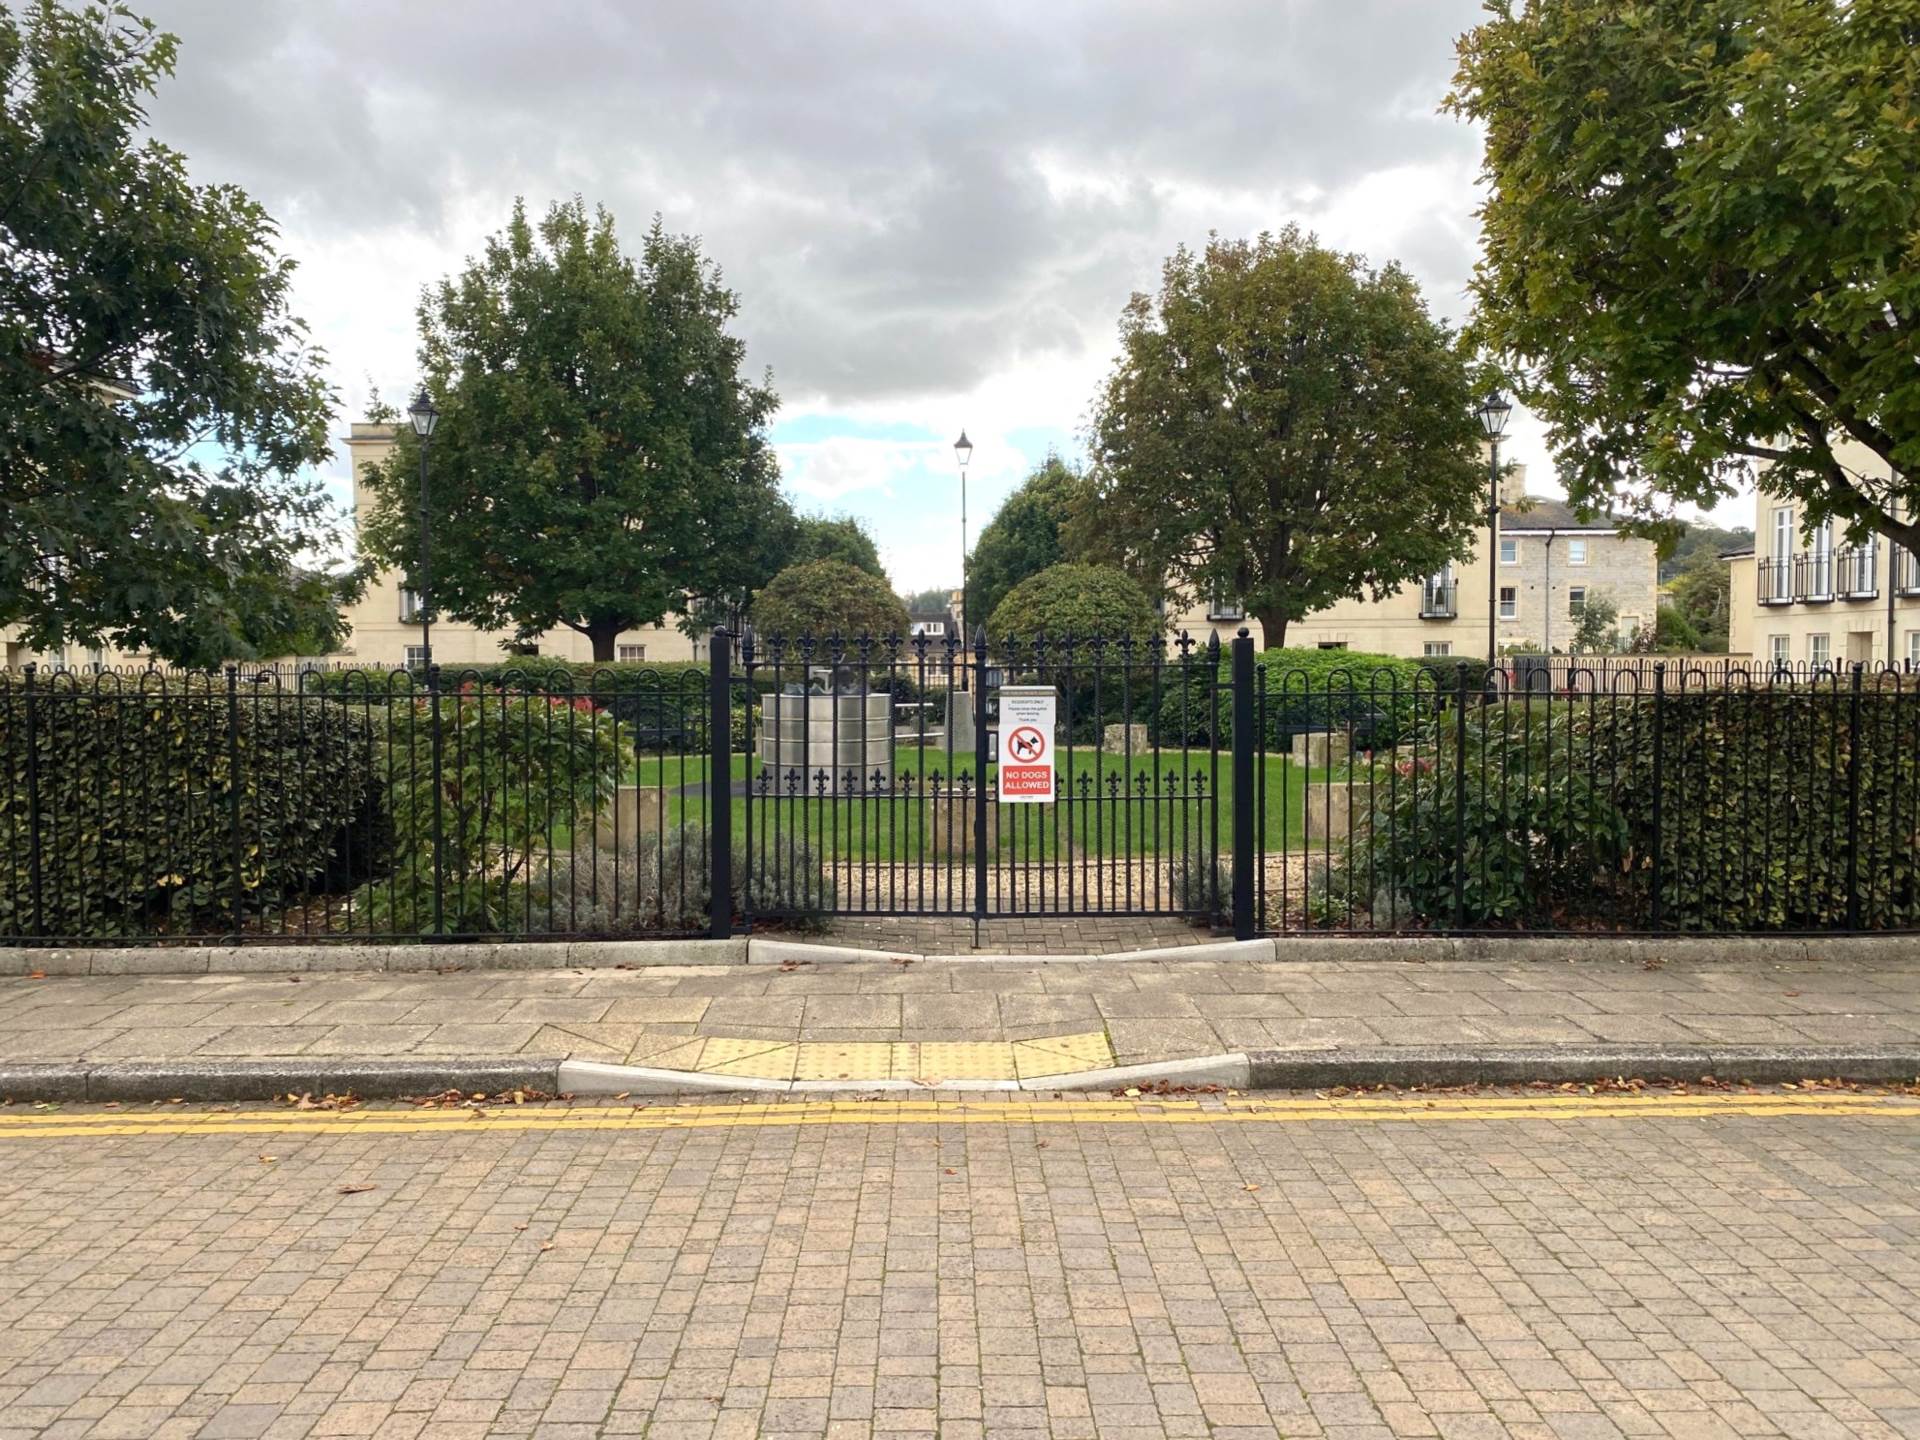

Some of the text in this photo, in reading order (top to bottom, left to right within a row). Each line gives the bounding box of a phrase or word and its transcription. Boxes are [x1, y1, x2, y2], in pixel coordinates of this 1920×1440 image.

[1006, 771, 1047, 779] NO DOGS
[1005, 781, 1049, 789] ALLOWED
